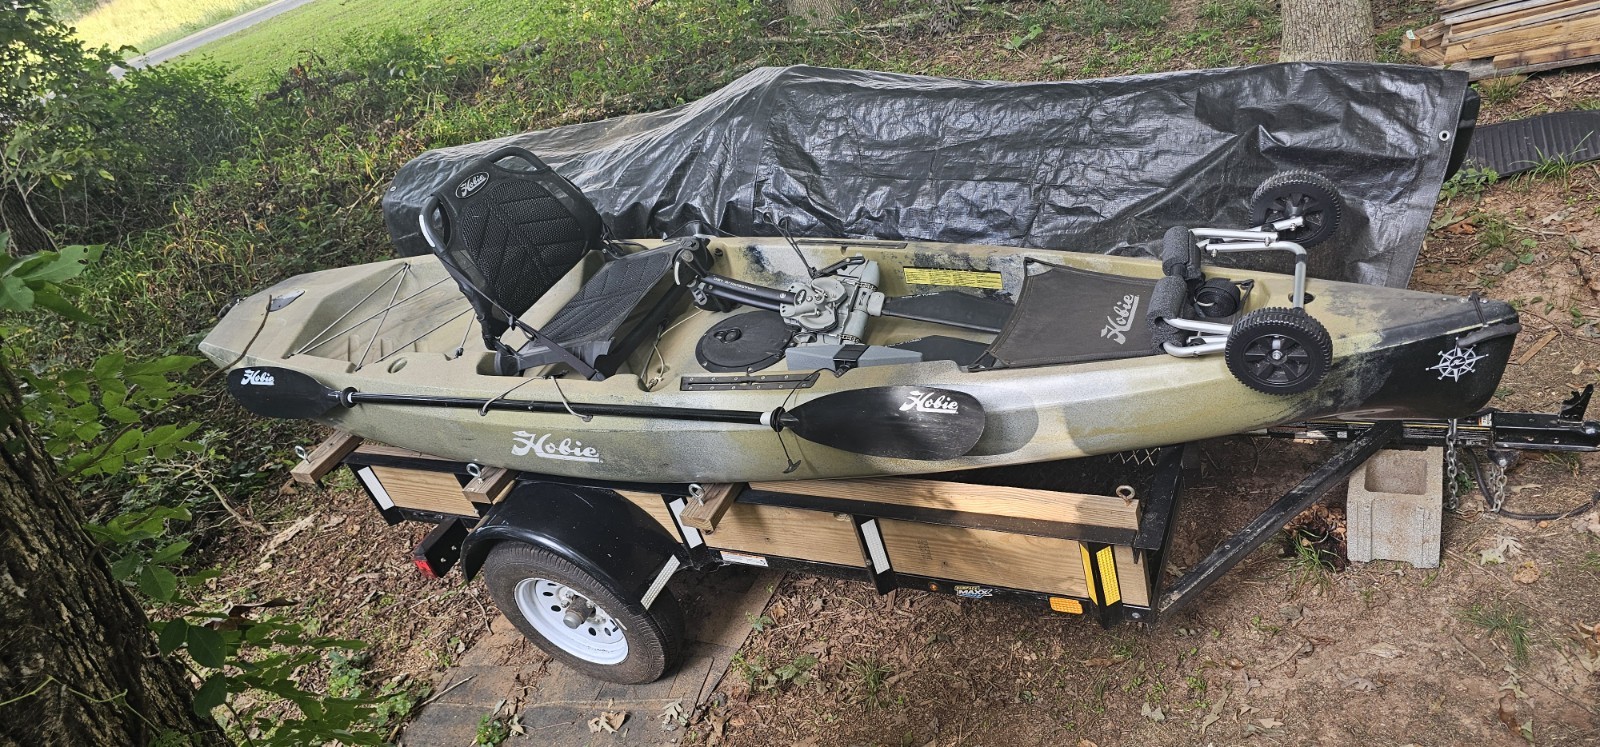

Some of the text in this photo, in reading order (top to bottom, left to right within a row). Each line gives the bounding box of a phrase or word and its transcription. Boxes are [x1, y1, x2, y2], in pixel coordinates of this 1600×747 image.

[460, 174, 487, 197] Hobie
[1100, 294, 1140, 345] Hobie
[240, 369, 275, 386] Hobie
[899, 390, 959, 414] Hobie
[511, 430, 603, 463] Hobie
